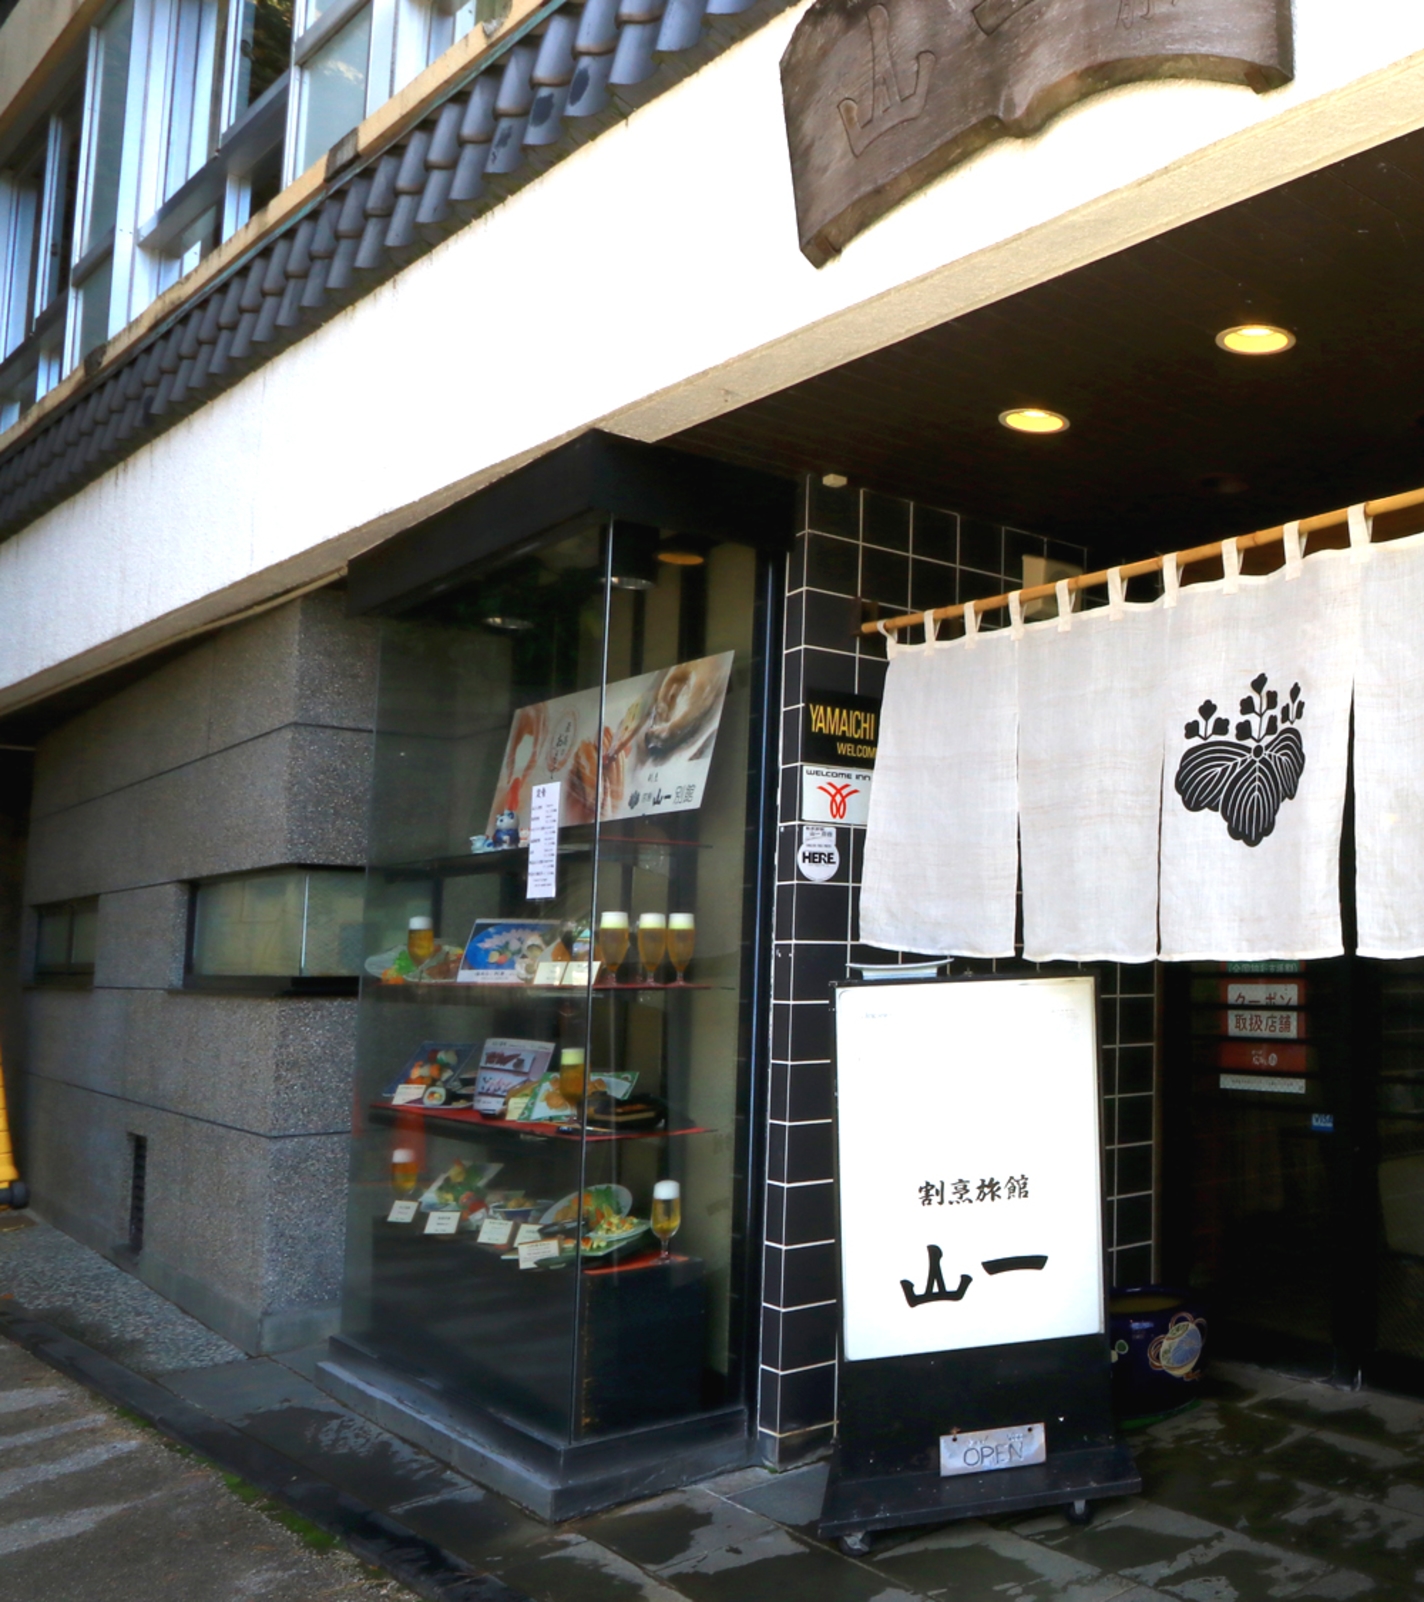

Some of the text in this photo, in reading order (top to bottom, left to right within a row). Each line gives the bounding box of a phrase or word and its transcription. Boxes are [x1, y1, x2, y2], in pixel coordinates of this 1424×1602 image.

[809, 703, 875, 741] YAMAICHI
[836, 742, 878, 759] WELCOM
[805, 769, 852, 780] WELCOME
[802, 851, 836, 865] HERE
[1234, 1014, 1292, 1033] 取扱店舗
[917, 1174, 1030, 1207] 割烹旅館
[899, 1243, 1049, 1309] 山一
[963, 1441, 1024, 1467] OPEN
